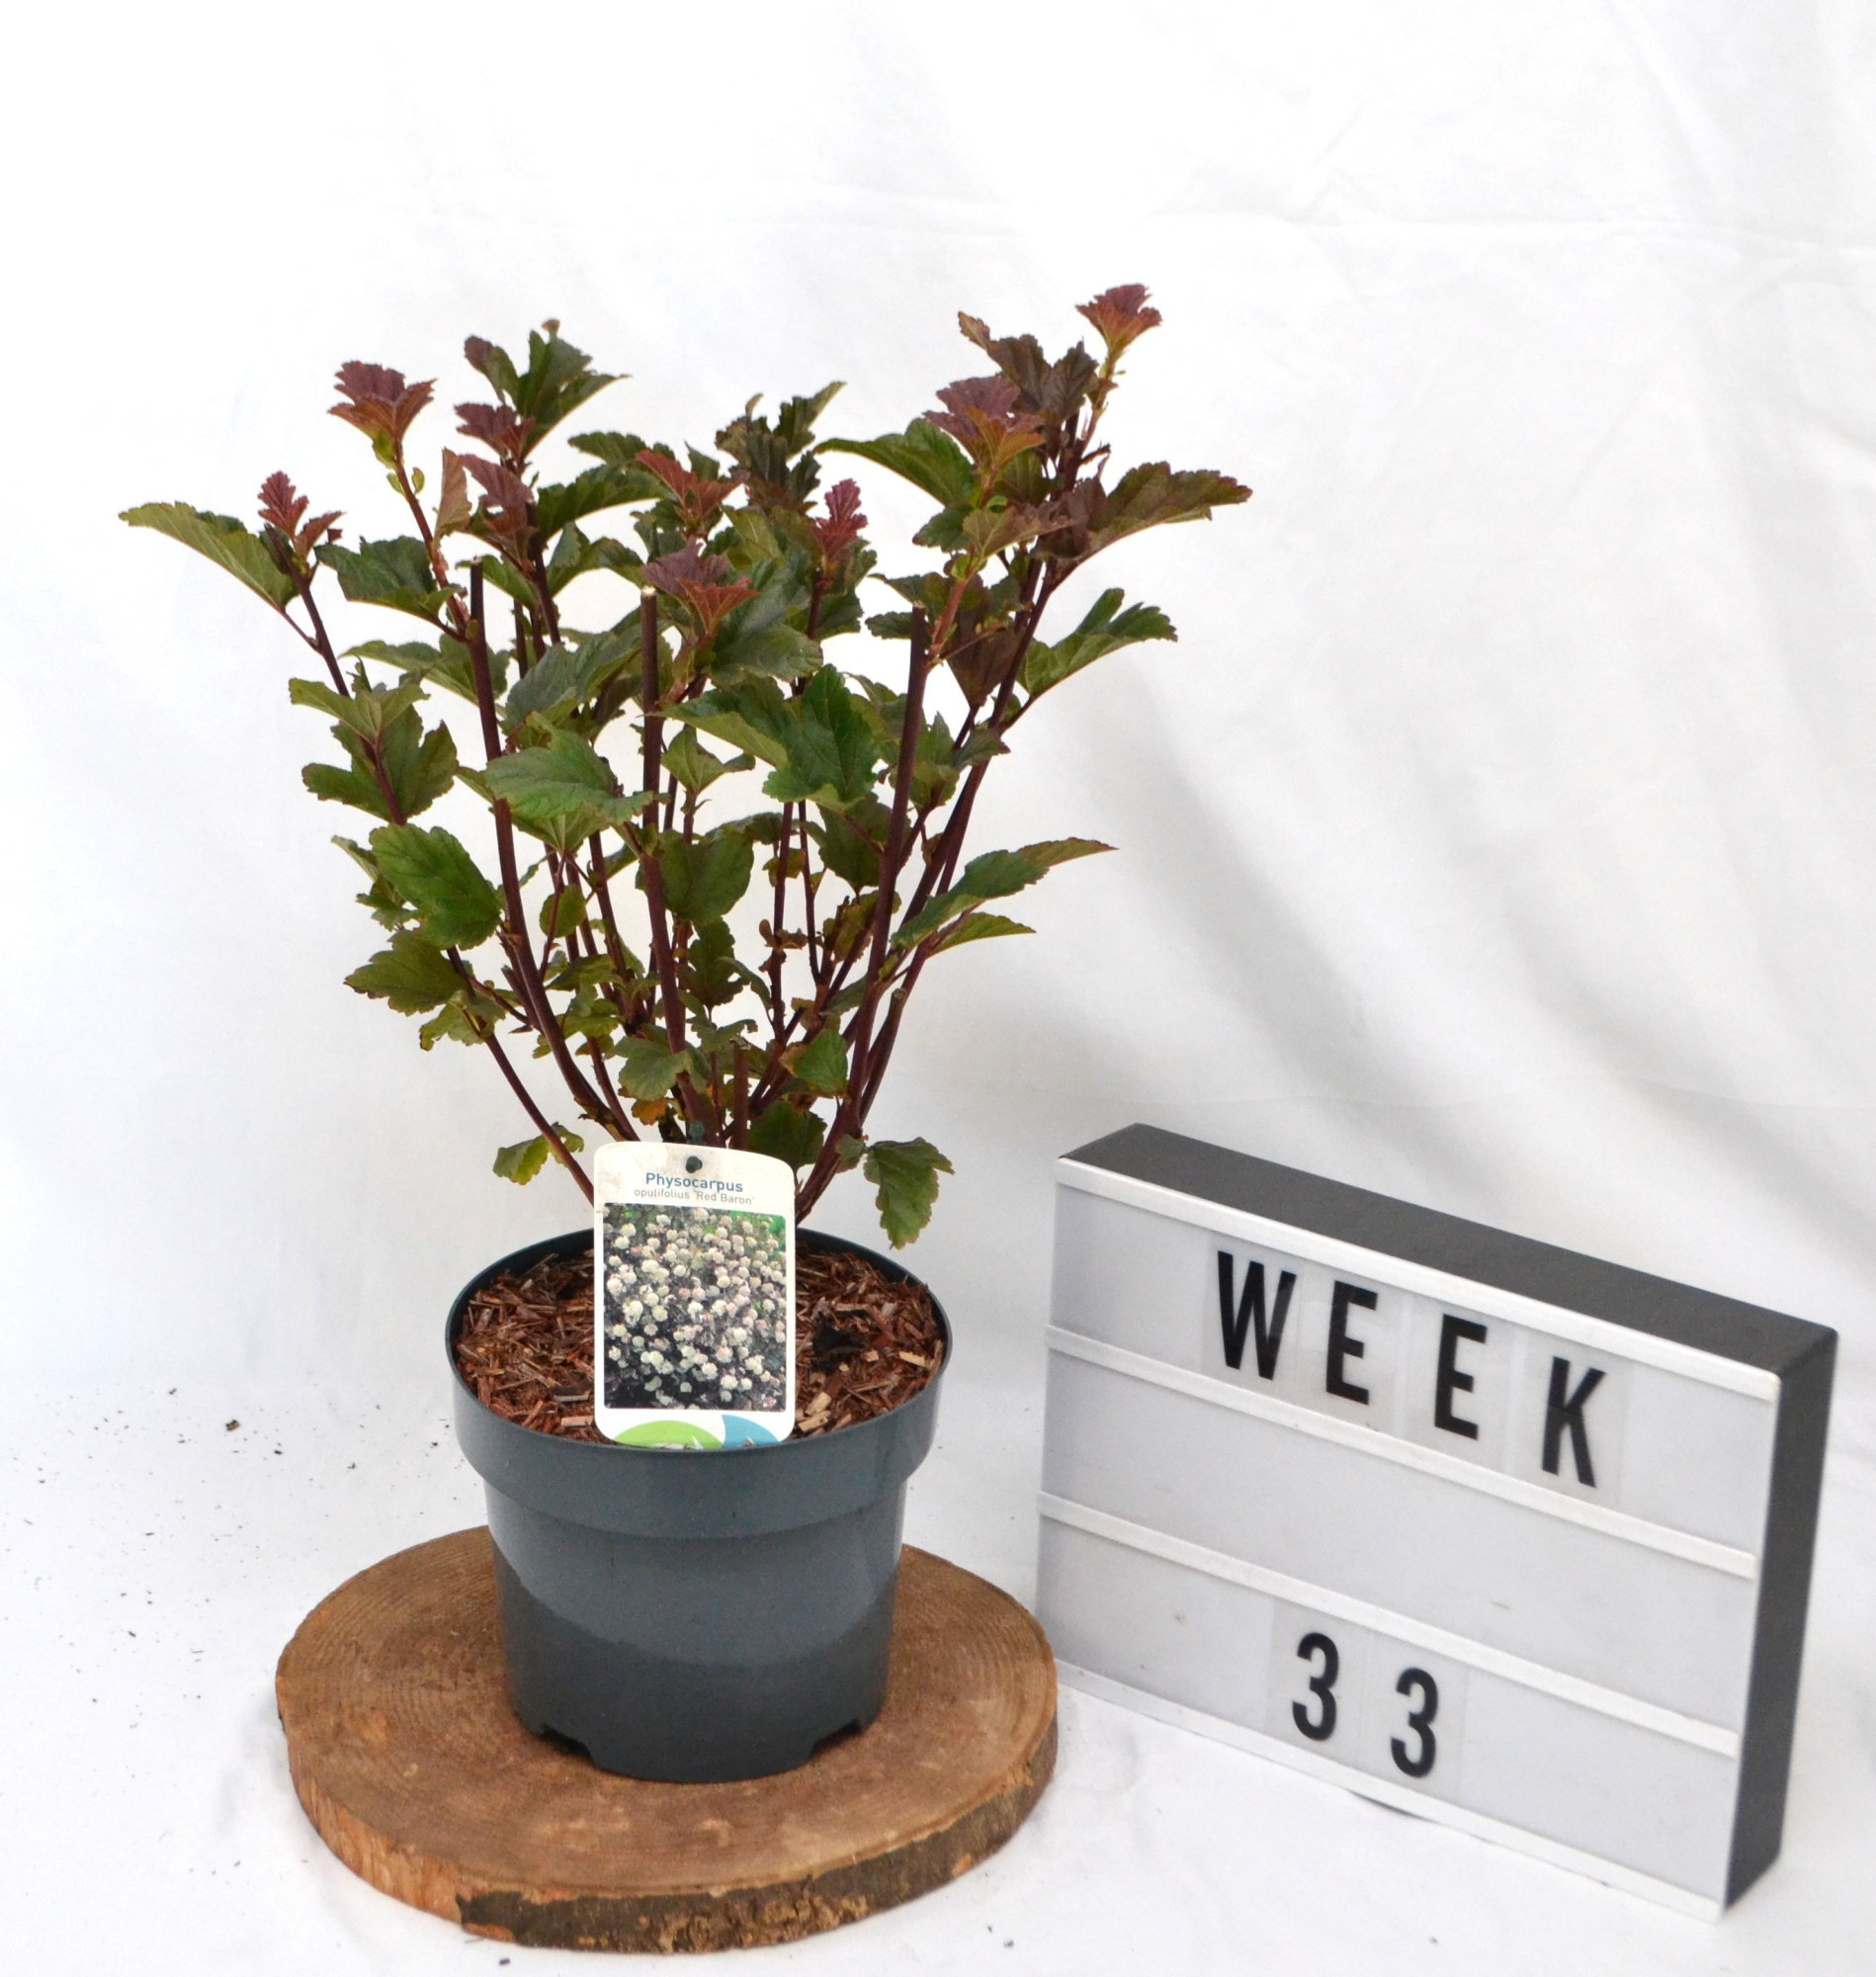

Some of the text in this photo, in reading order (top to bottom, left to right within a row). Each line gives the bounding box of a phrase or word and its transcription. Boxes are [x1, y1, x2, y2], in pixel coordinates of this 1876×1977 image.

[645, 1172, 744, 1193] Physocarpus
[634, 1188, 690, 1200] opulifolius
[1217, 1250, 1606, 1489] WEEK
